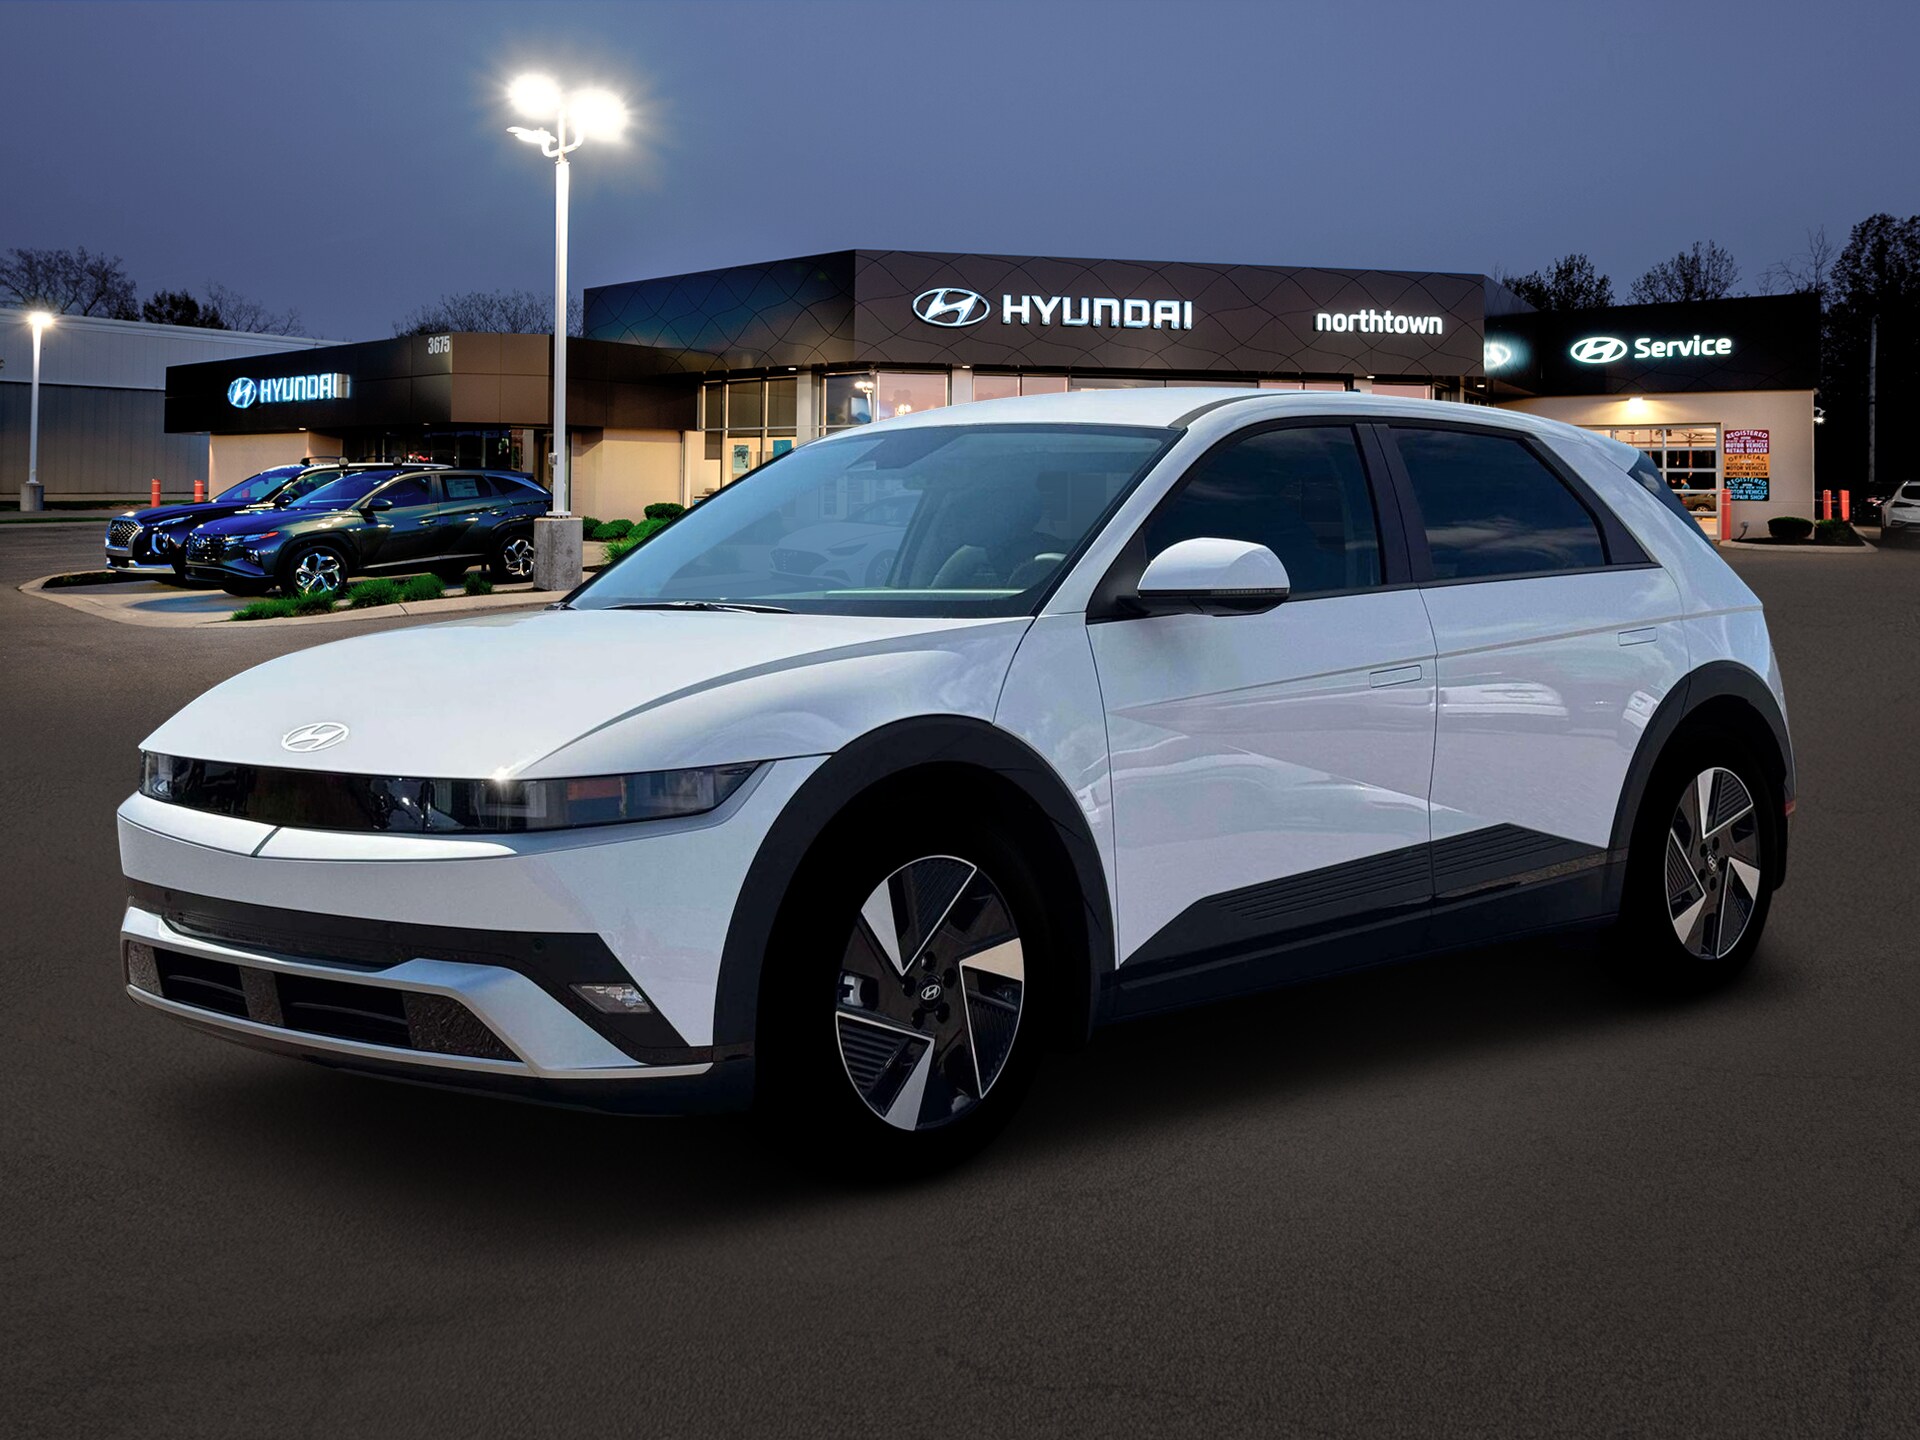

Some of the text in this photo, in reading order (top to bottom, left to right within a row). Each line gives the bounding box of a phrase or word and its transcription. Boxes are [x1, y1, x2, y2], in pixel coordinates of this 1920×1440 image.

[1002, 294, 1193, 330] HYUNDAI
[1315, 308, 1443, 336] northtown
[428, 335, 450, 355] 3675
[1633, 334, 1733, 359] Service
[260, 373, 337, 403] HYUNDAI
[1726, 430, 1768, 439] REGISTERED
[1728, 454, 1766, 462] OFFICIAL
[1726, 477, 1767, 486] REGISTERED
